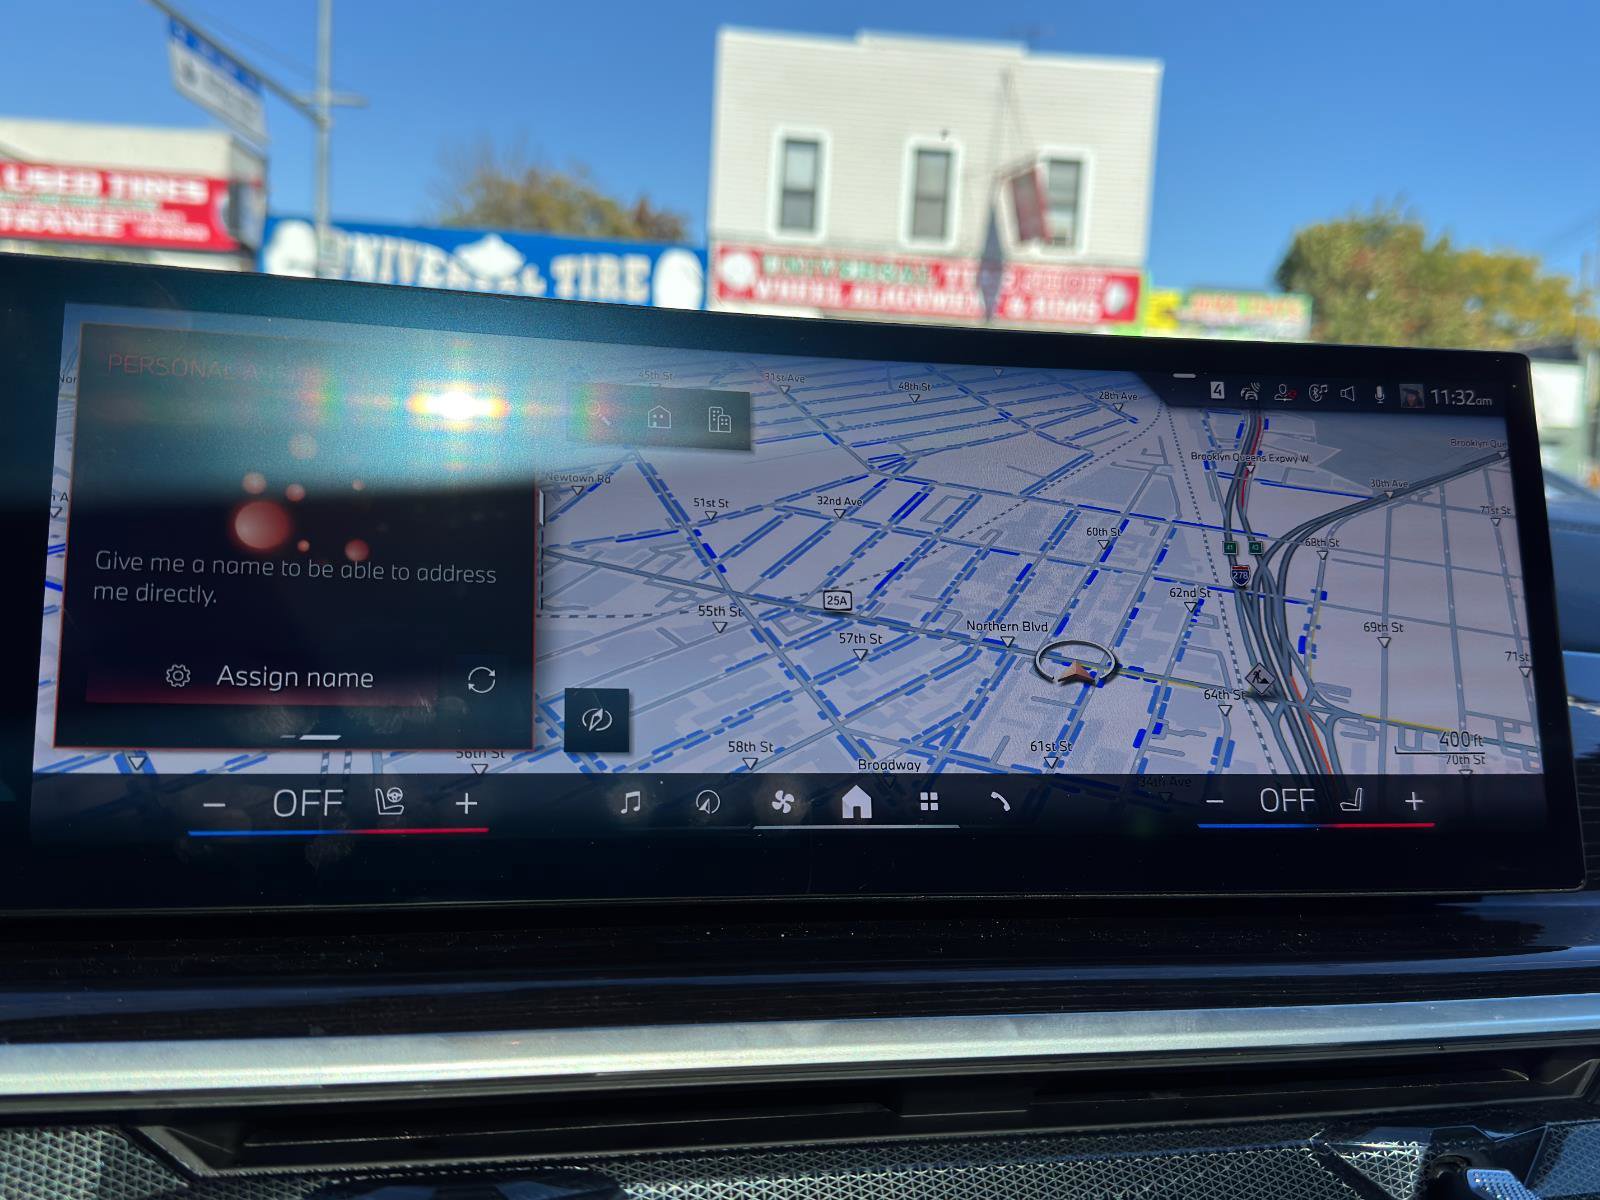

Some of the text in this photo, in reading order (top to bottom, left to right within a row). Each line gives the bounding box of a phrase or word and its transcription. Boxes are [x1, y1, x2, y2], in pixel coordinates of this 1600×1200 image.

[765, 373, 805, 383] 31st Ave
[898, 382, 931, 391] 48th St
[1099, 391, 1138, 400] 28th Ave
[1450, 439, 1487, 448] Brooklyn
[1191, 452, 1230, 462] Brooklyn
[1232, 453, 1266, 463] Queens
[1269, 454, 1297, 464] Expwy
[545, 473, 611, 484] Newtown Rd
[1370, 479, 1408, 488] 30th Ave
[693, 498, 729, 508] 51st St
[817, 496, 863, 506] 32nd Ave
[1480, 506, 1511, 515] 71st St
[1086, 527, 1121, 537] 60th St
[1305, 537, 1340, 547] 68th St
[95, 550, 496, 583] Give me a name to be able to address
[1232, 571, 1248, 579] 278
[94, 584, 217, 607] me directly.
[1169, 588, 1211, 598] 62nd St
[827, 596, 848, 606] 25A
[698, 606, 742, 617] 55th St
[966, 620, 1048, 632] Northern Blvd
[1363, 622, 1403, 633] 69th St
[839, 633, 883, 644] 57th St
[216, 665, 374, 692] Assign name
[1204, 689, 1246, 701] 64th St
[1440, 731, 1483, 747] 400 ft
[728, 741, 774, 753] 58th St
[1030, 741, 1072, 752] 61st St
[858, 759, 921, 772] Broadway
[1473, 755, 1485, 765] St
[274, 789, 345, 817] OFF
[1260, 788, 1315, 812] OFF
